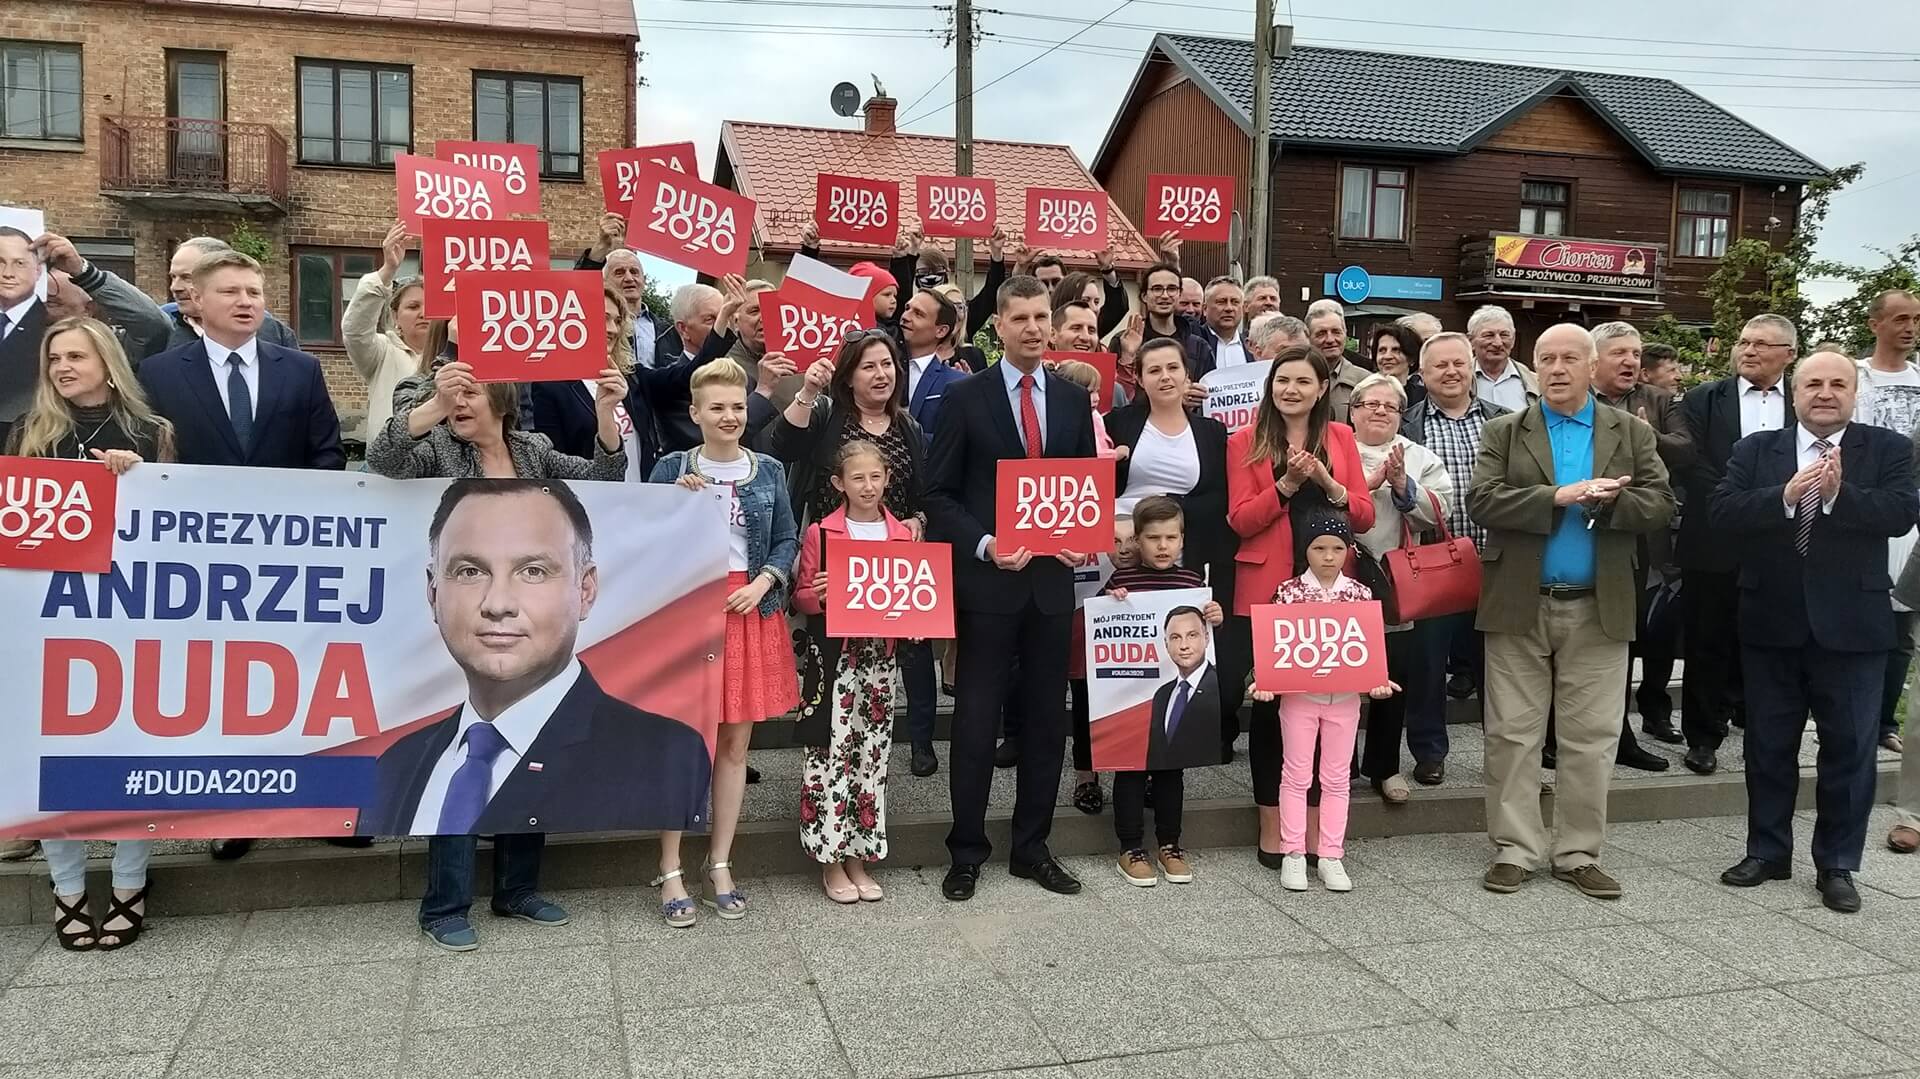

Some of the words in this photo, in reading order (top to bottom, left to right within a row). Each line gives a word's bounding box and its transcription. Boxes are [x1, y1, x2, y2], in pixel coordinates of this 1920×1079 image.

[415, 169, 491, 204] DUDA
[830, 186, 888, 211] DUDA
[929, 186, 986, 205] DUDA
[1161, 185, 1221, 206] DUDA
[415, 192, 493, 220] 2020
[655, 182, 736, 234] DUDA
[828, 204, 888, 228] 2020
[928, 203, 987, 221] 2020
[1039, 199, 1097, 218] DUDA
[1158, 204, 1221, 223] 2020
[648, 206, 735, 255] 2020
[1037, 215, 1097, 234] 2020
[444, 237, 533, 265] DUDA
[1539, 241, 1615, 269] Chorten
[1342, 279, 1366, 290] blue
[1496, 268, 1525, 278] SKLEP
[1525, 269, 1581, 282] SPOŻYWCZO
[1586, 274, 1652, 287] PRZEMYSŁOWY
[481, 290, 586, 321] DUDA
[481, 319, 588, 352] 2020
[1210, 392, 1261, 408] ANDRZEJ
[0, 476, 93, 511] UDA
[1017, 475, 1100, 503] DUDA
[0, 506, 93, 541] 020
[1015, 500, 1101, 529] 2020
[152, 510, 387, 549] PREZYDENT
[848, 556, 937, 585] DUDA
[40, 560, 386, 625] ANDRZEJ
[846, 582, 937, 611] 2020
[1093, 615, 1110, 624] MÓJ
[1111, 613, 1156, 622] PREZYDENT
[1093, 625, 1158, 640] ANDRZEJ
[1273, 616, 1367, 644] DUDA
[1094, 643, 1159, 664] DUDA
[1273, 641, 1369, 669] 2020
[41, 638, 382, 738] DUDA
[125, 769, 298, 796] #DUDA2020
